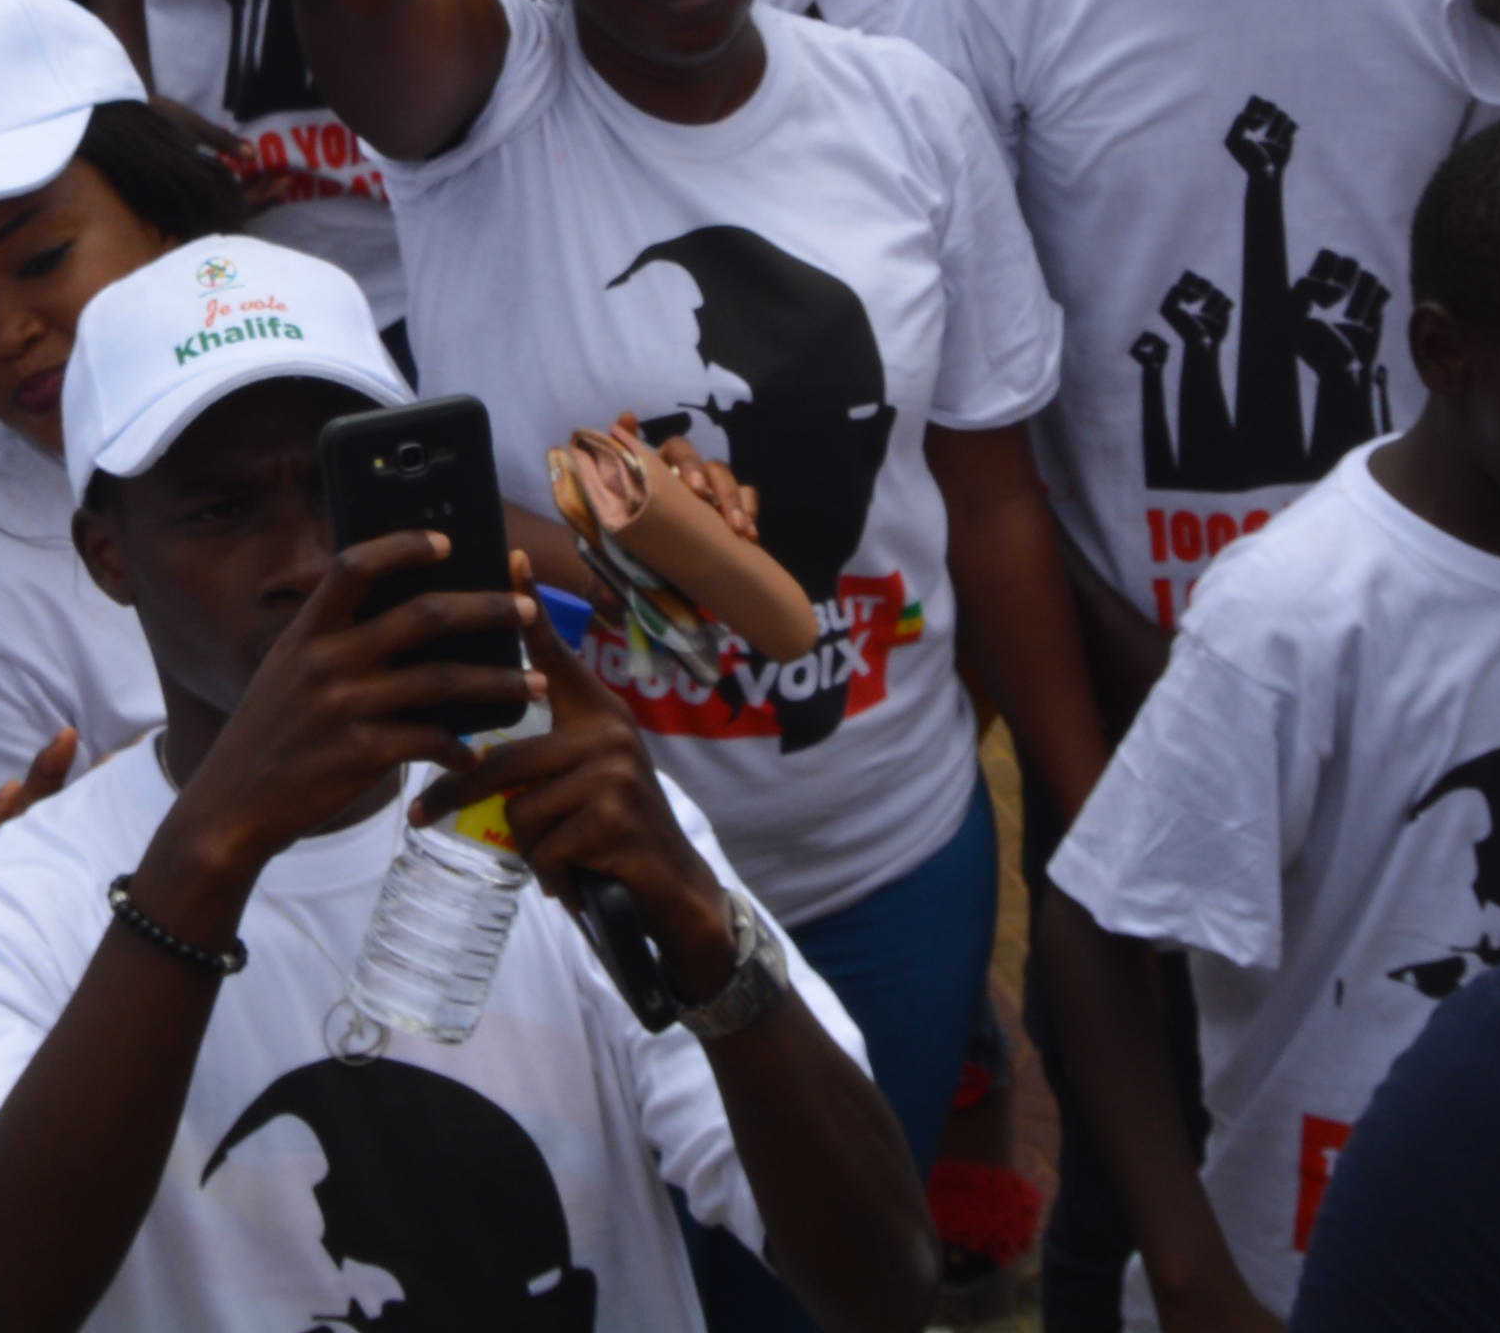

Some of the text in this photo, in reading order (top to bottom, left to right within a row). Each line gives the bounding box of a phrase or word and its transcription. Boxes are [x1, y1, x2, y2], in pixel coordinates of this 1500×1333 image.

[203, 294, 289, 329] Je vote
[172, 313, 306, 367] Khalifa
[732, 631, 872, 709] VOIX
